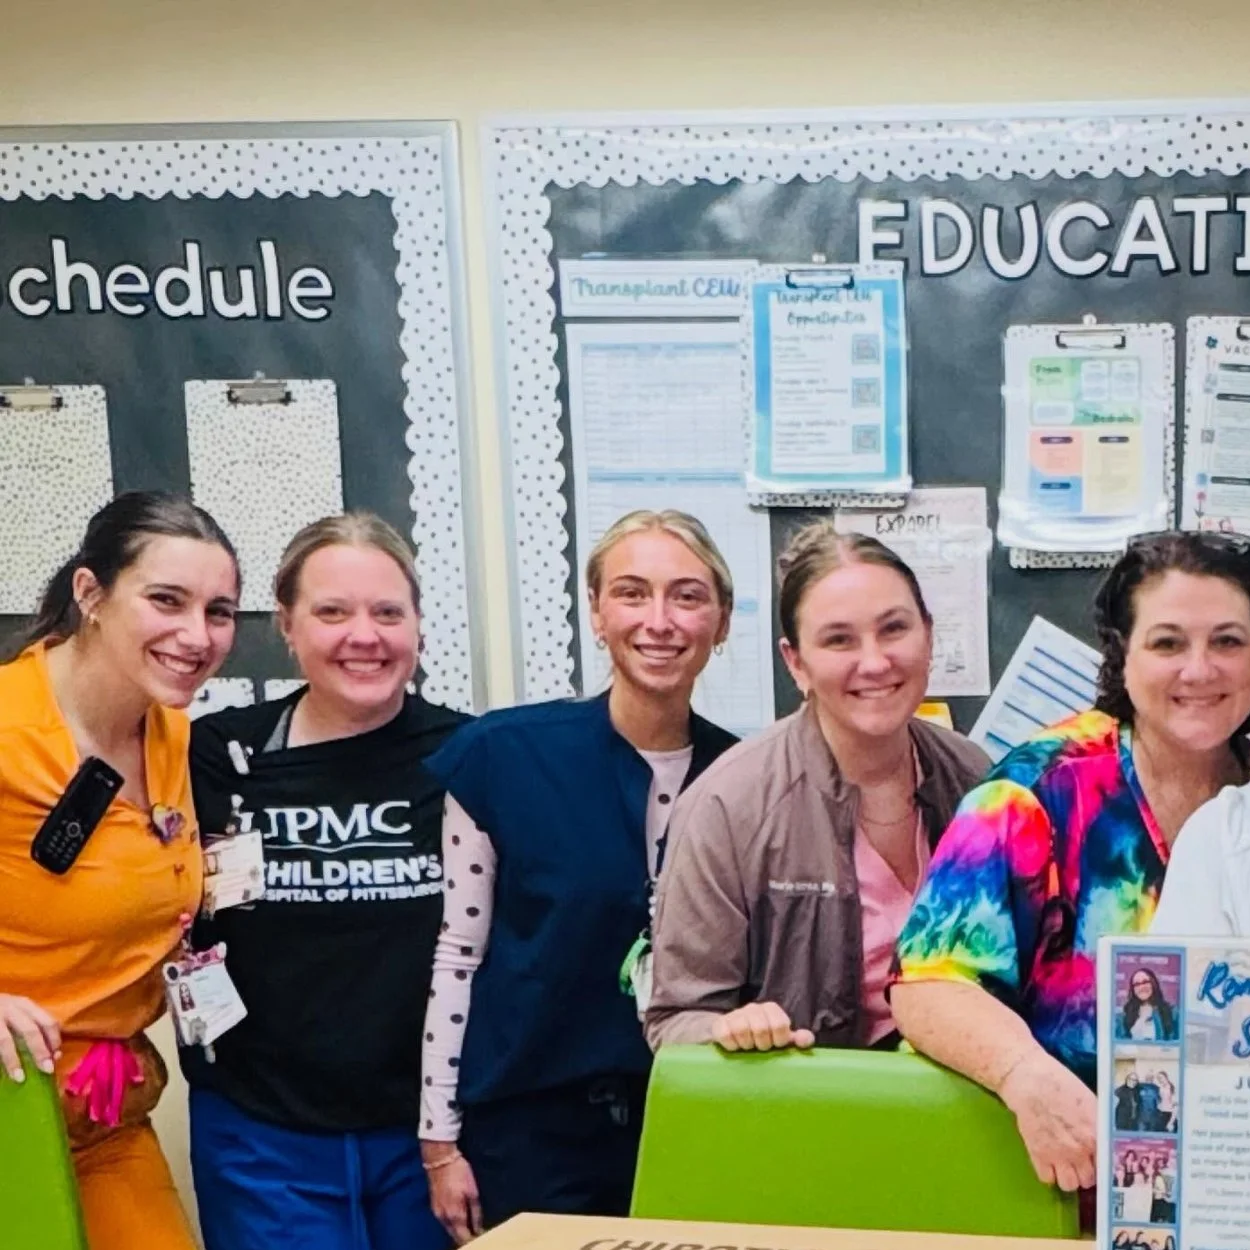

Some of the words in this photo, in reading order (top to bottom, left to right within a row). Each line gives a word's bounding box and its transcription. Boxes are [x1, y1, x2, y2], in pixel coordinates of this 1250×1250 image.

[6, 236, 338, 321] chedule
[571, 277, 690, 302] Transplant
[1224, 344, 1250, 355] VAC
[263, 852, 442, 887] HILDREN'S
[264, 888, 323, 903] SPITAL
[324, 888, 350, 903] OF
